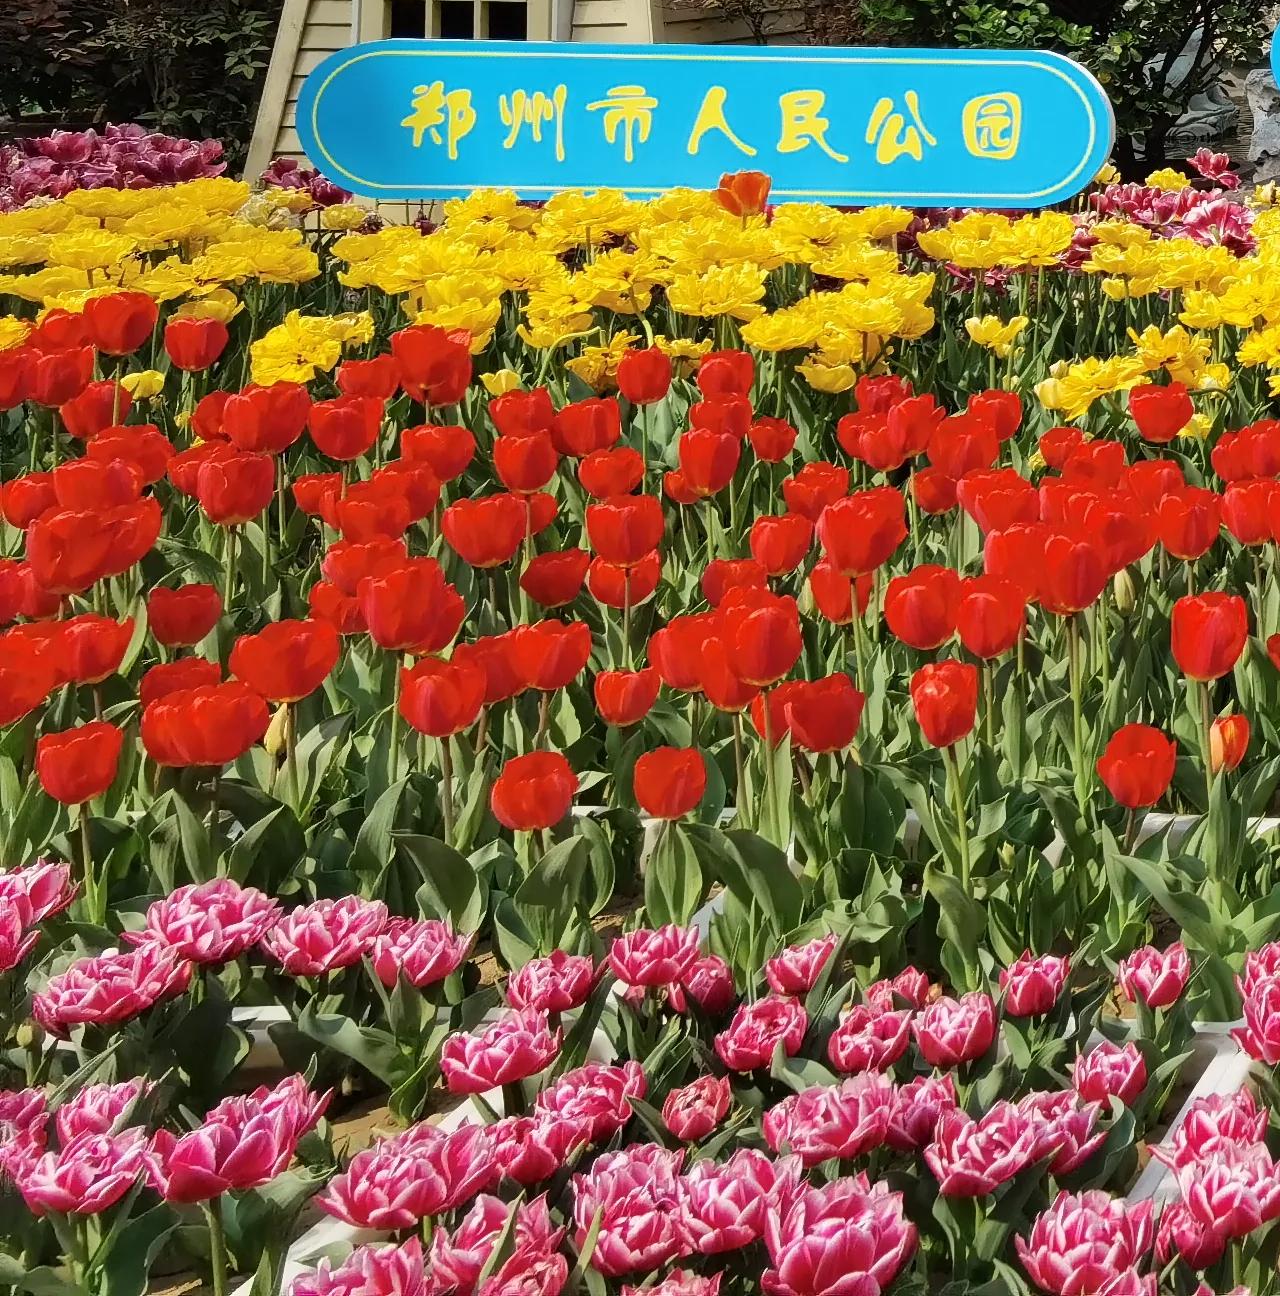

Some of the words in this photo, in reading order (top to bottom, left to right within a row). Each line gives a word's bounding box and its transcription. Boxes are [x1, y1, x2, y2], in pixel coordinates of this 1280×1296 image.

[400, 80, 1024, 164] 郑州市人民公园
